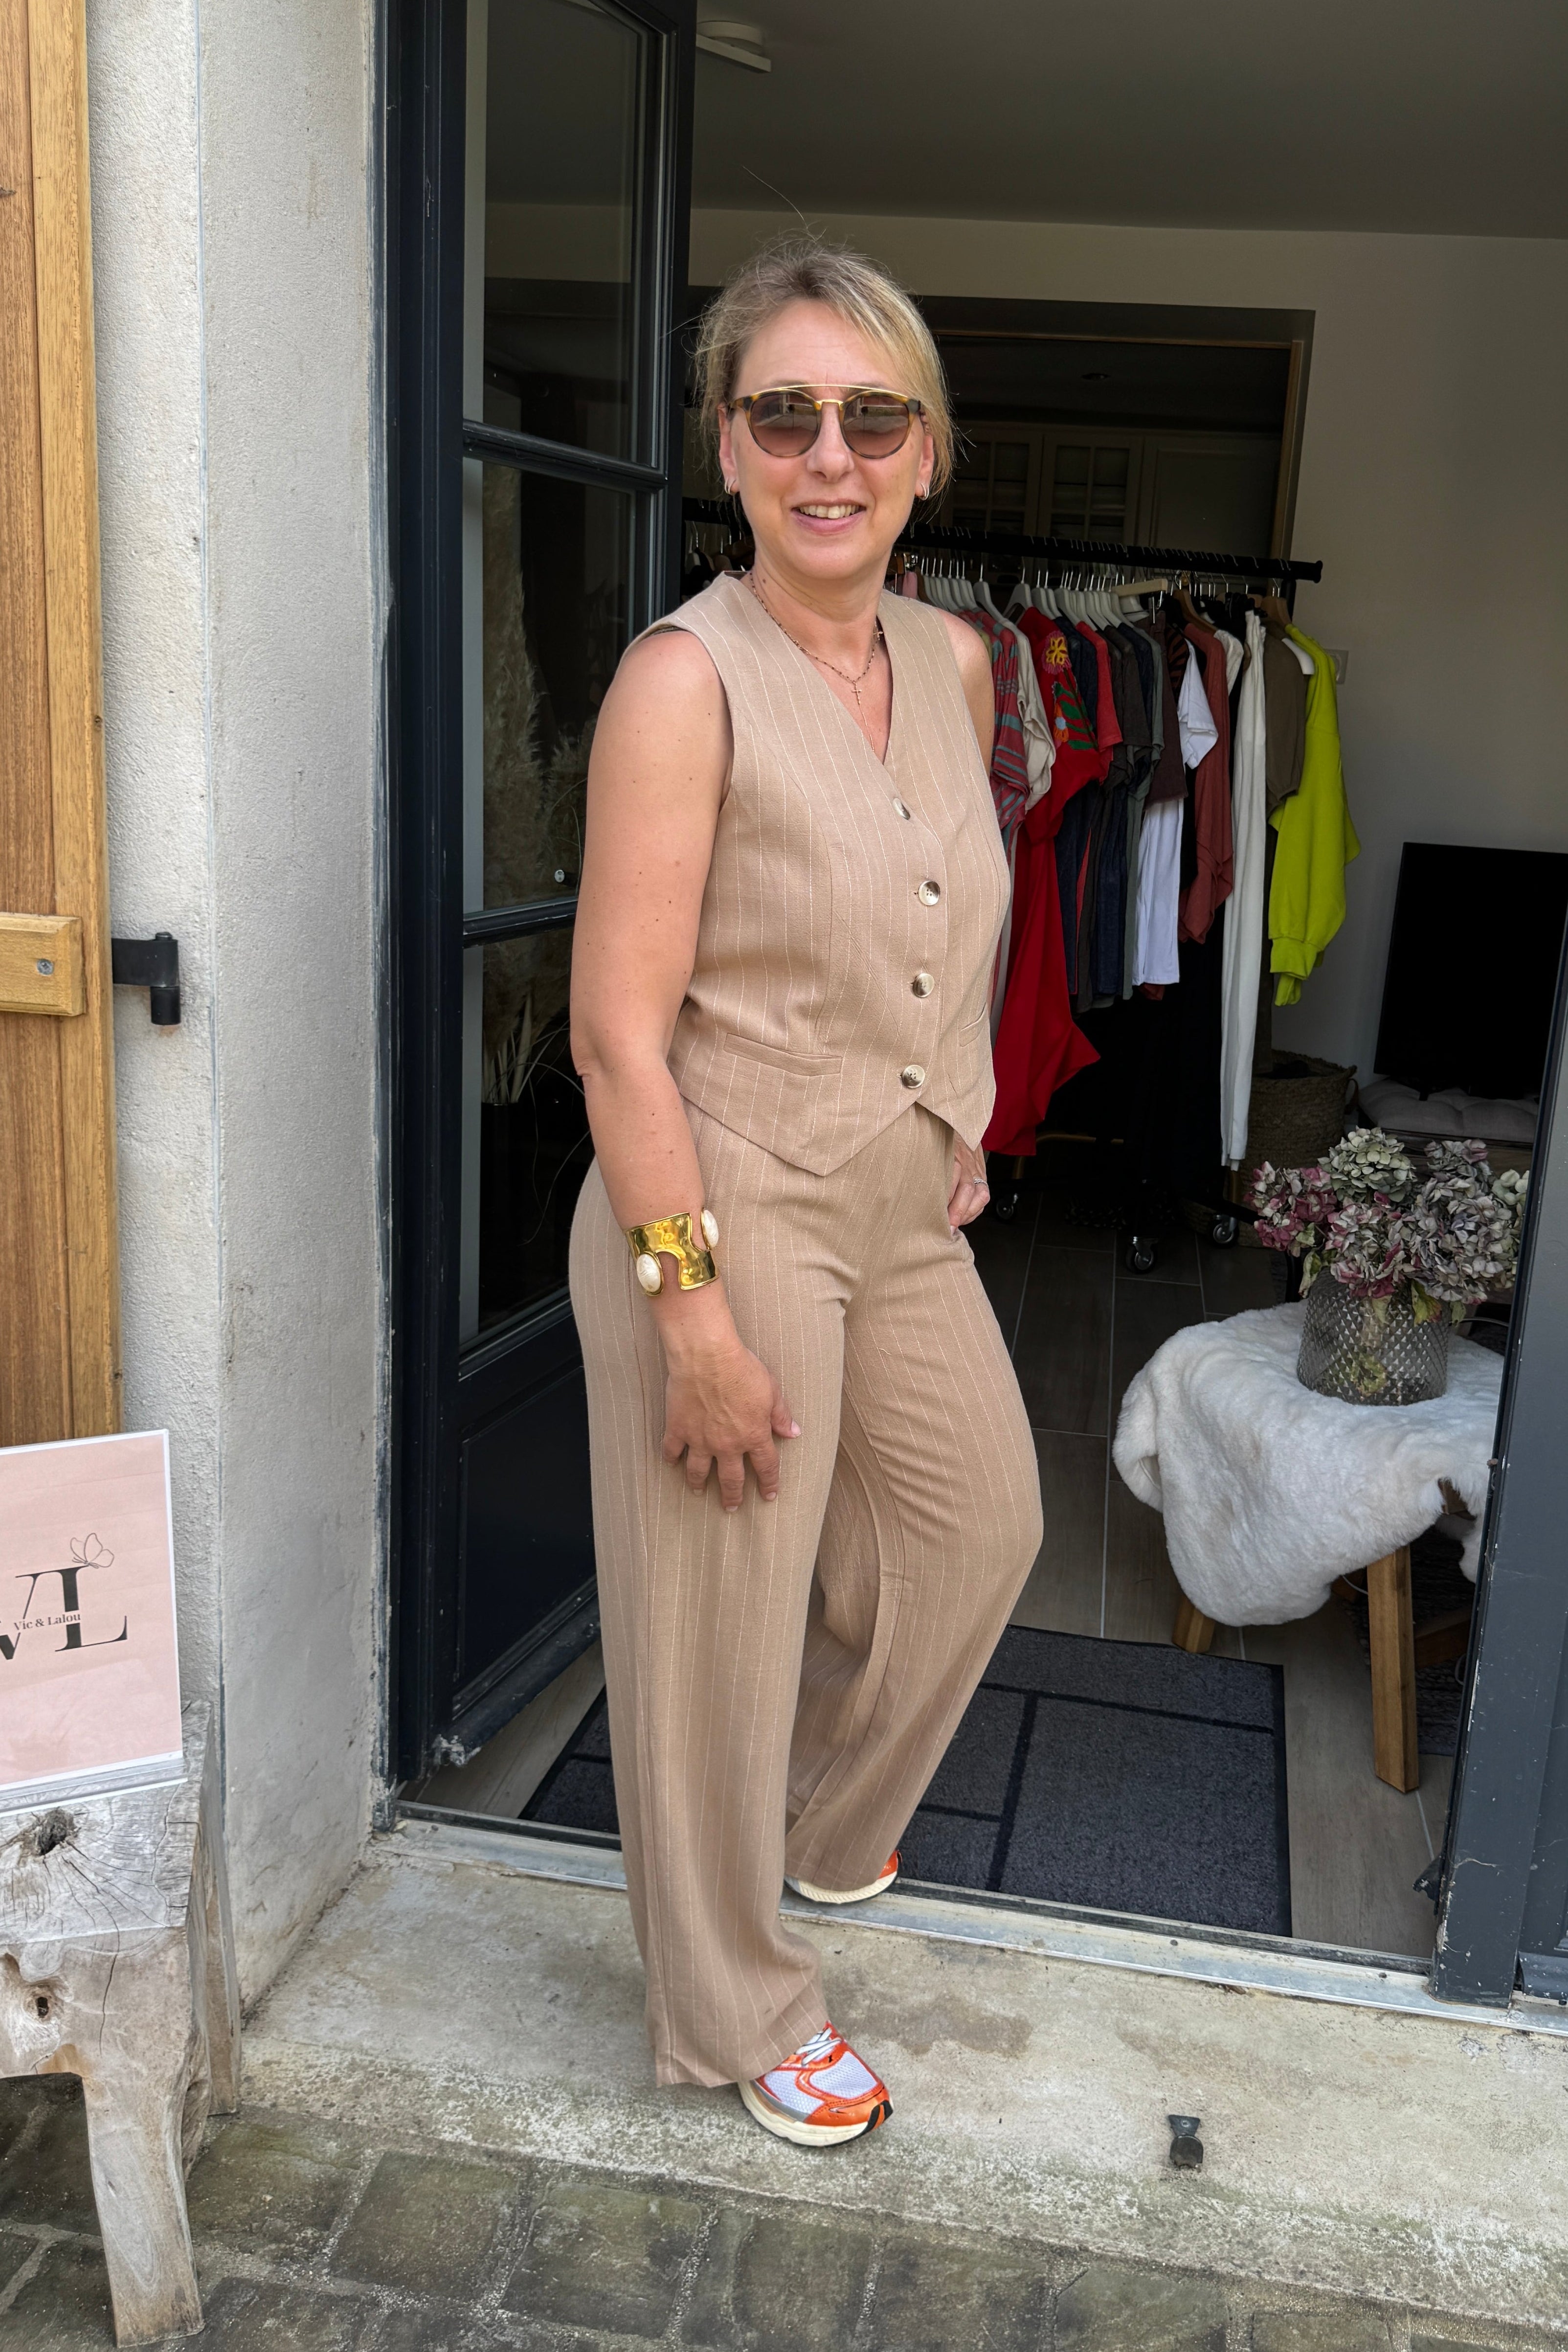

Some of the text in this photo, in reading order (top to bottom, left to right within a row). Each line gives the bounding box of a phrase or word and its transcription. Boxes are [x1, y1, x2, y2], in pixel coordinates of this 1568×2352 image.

[14, 1614, 81, 1630] Vic & Lalou
